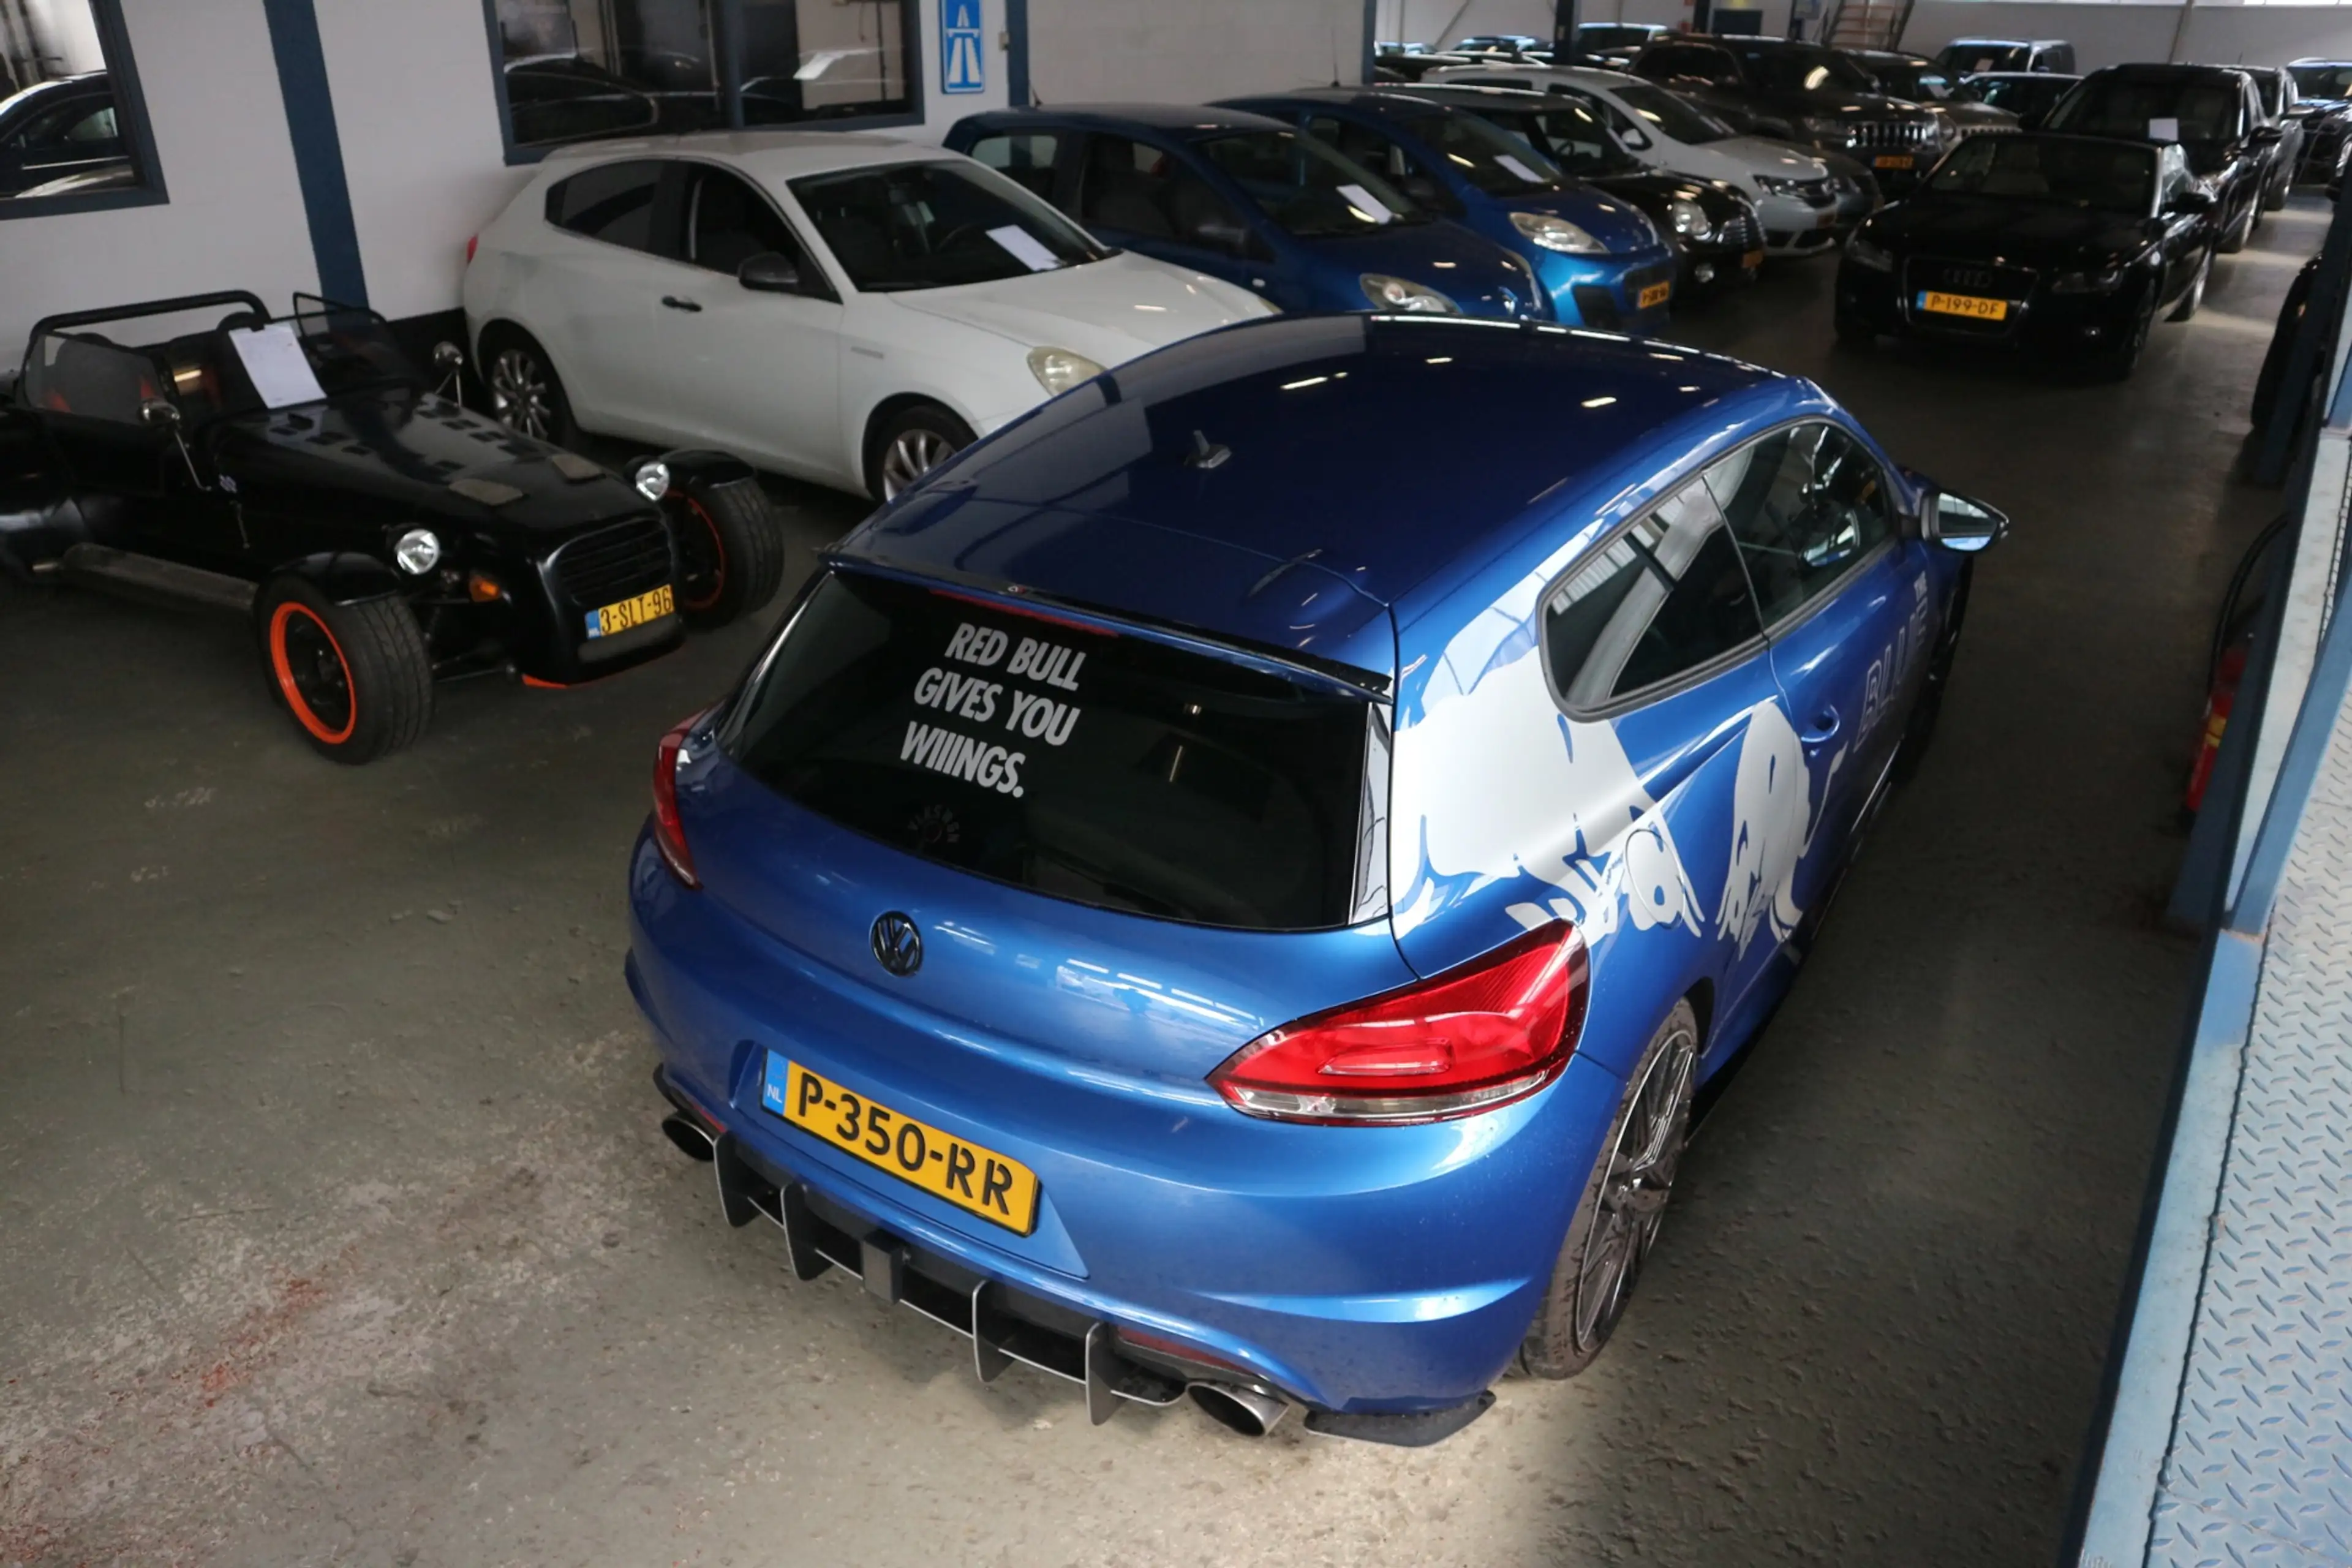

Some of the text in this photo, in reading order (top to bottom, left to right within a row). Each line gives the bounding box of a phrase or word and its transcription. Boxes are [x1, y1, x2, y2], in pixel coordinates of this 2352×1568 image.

[1931, 295, 1999, 314] P-199-DF
[600, 587, 671, 633] 3-SLT-96
[944, 624, 1086, 691] RED BULL
[914, 668, 1081, 746] GIVES YOU
[767, 1084, 783, 1104] NL
[799, 1072, 1012, 1215] P-350-RR
